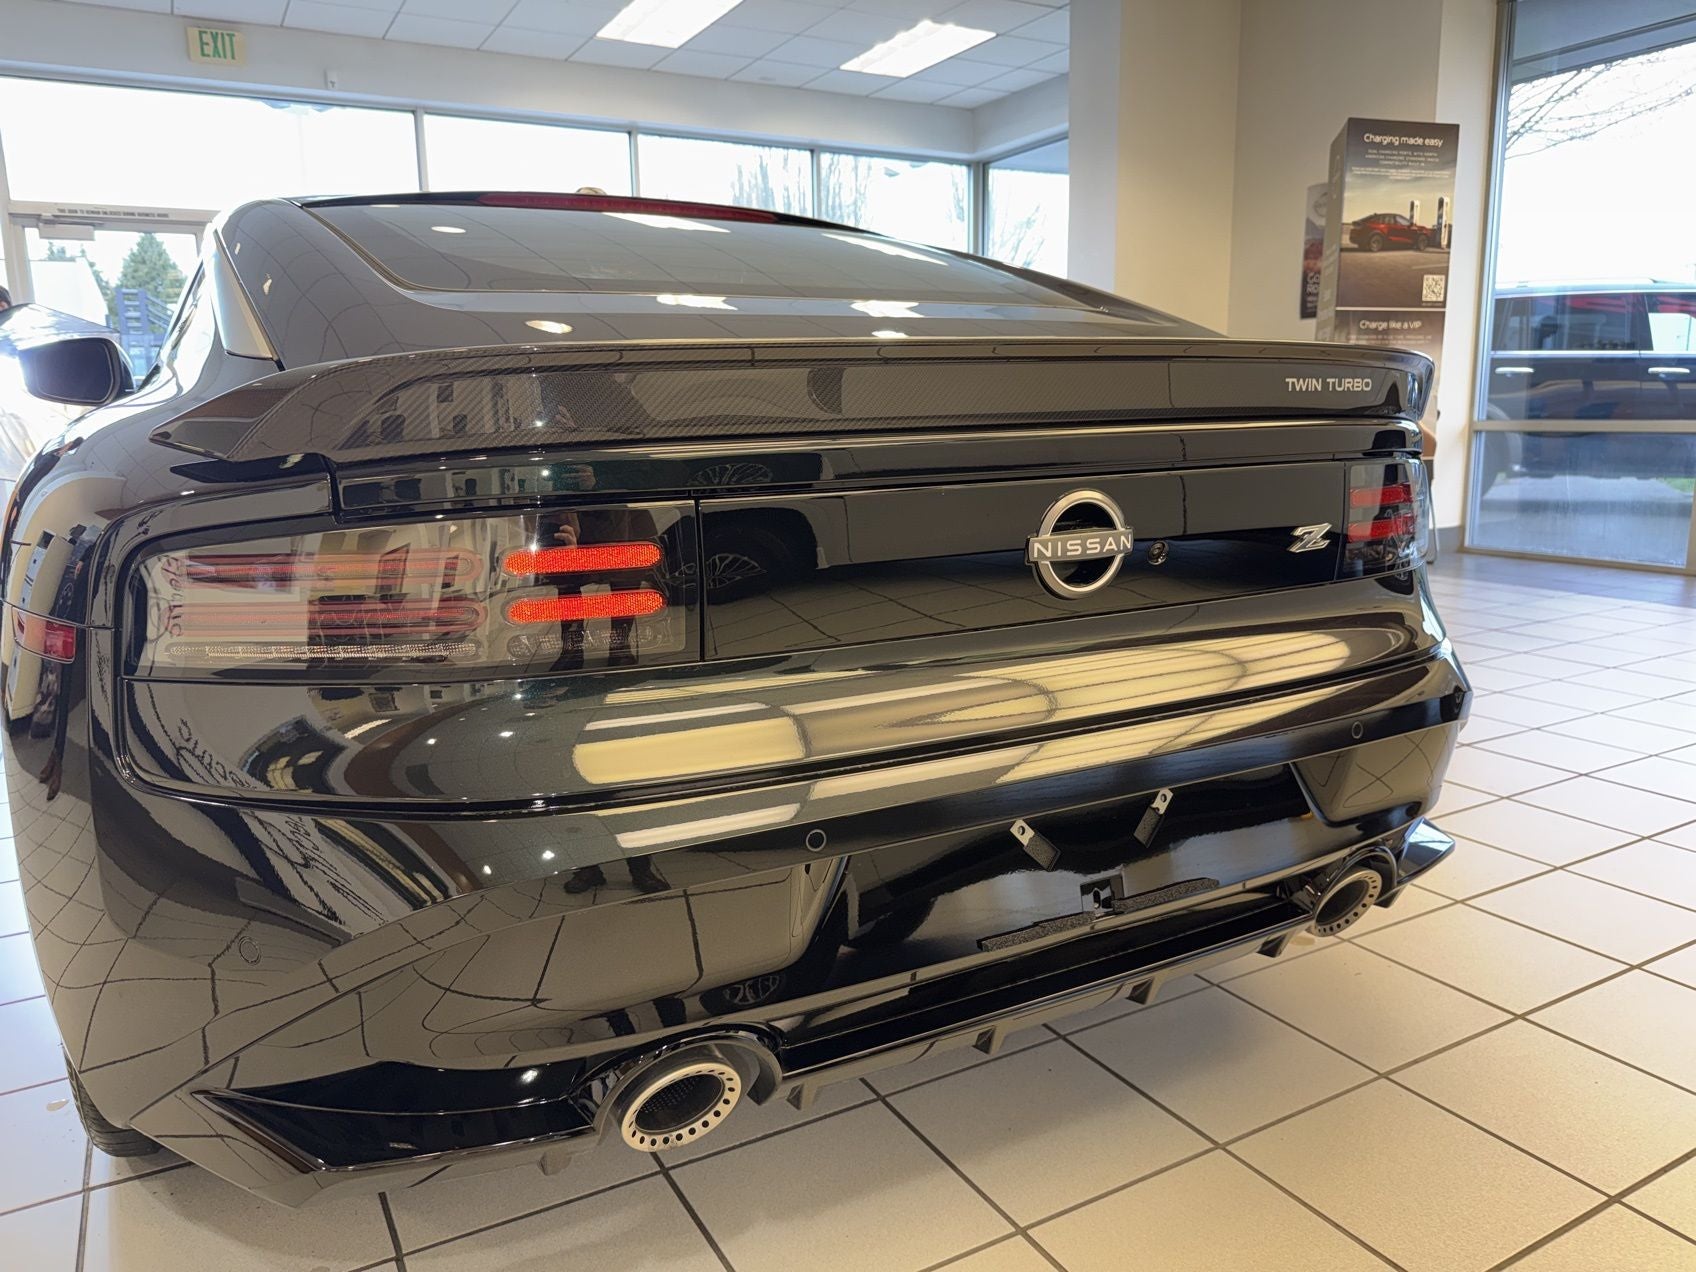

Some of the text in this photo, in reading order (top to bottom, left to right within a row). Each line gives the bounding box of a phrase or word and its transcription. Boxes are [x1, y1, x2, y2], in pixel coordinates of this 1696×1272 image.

[198, 30, 236, 60] EXIT
[1363, 133, 1443, 148] Charging made easy
[1359, 320, 1388, 331] Charge
[1389, 320, 1401, 329] like
[1409, 320, 1421, 329] VIP
[1285, 378, 1372, 391] TWIN TURBO
[1033, 534, 1132, 558] NISSAN
[1287, 522, 1332, 553] Z
